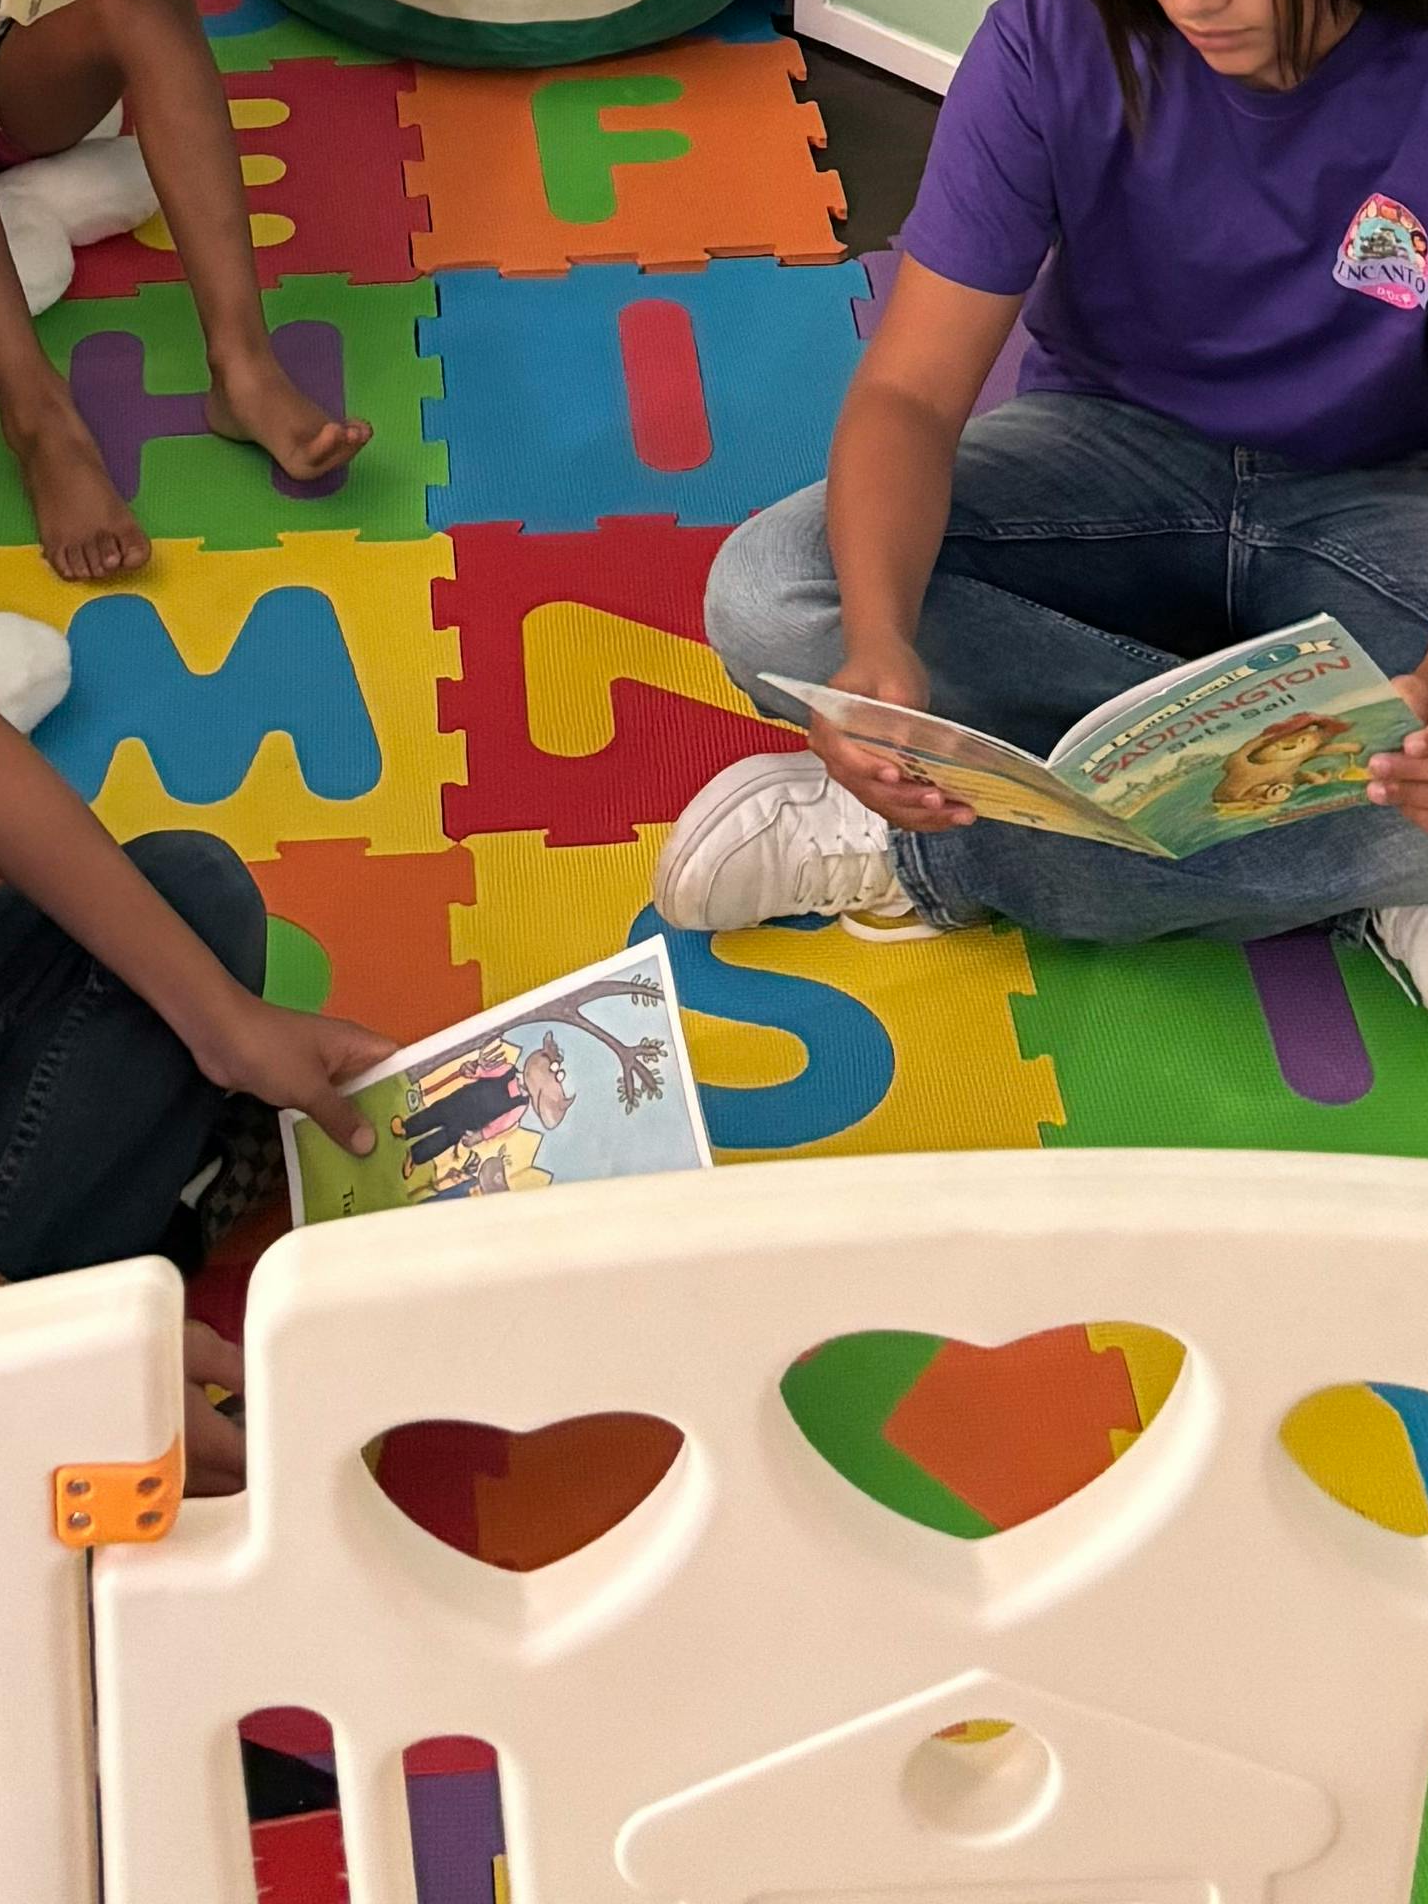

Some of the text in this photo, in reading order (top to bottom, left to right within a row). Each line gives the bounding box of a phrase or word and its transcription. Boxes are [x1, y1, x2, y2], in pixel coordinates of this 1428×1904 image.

[533, 75, 691, 223] F
[32, 586, 383, 802] M
[1091, 655, 1351, 784] PADDINGTON
[1240, 693, 1296, 721] Sail
